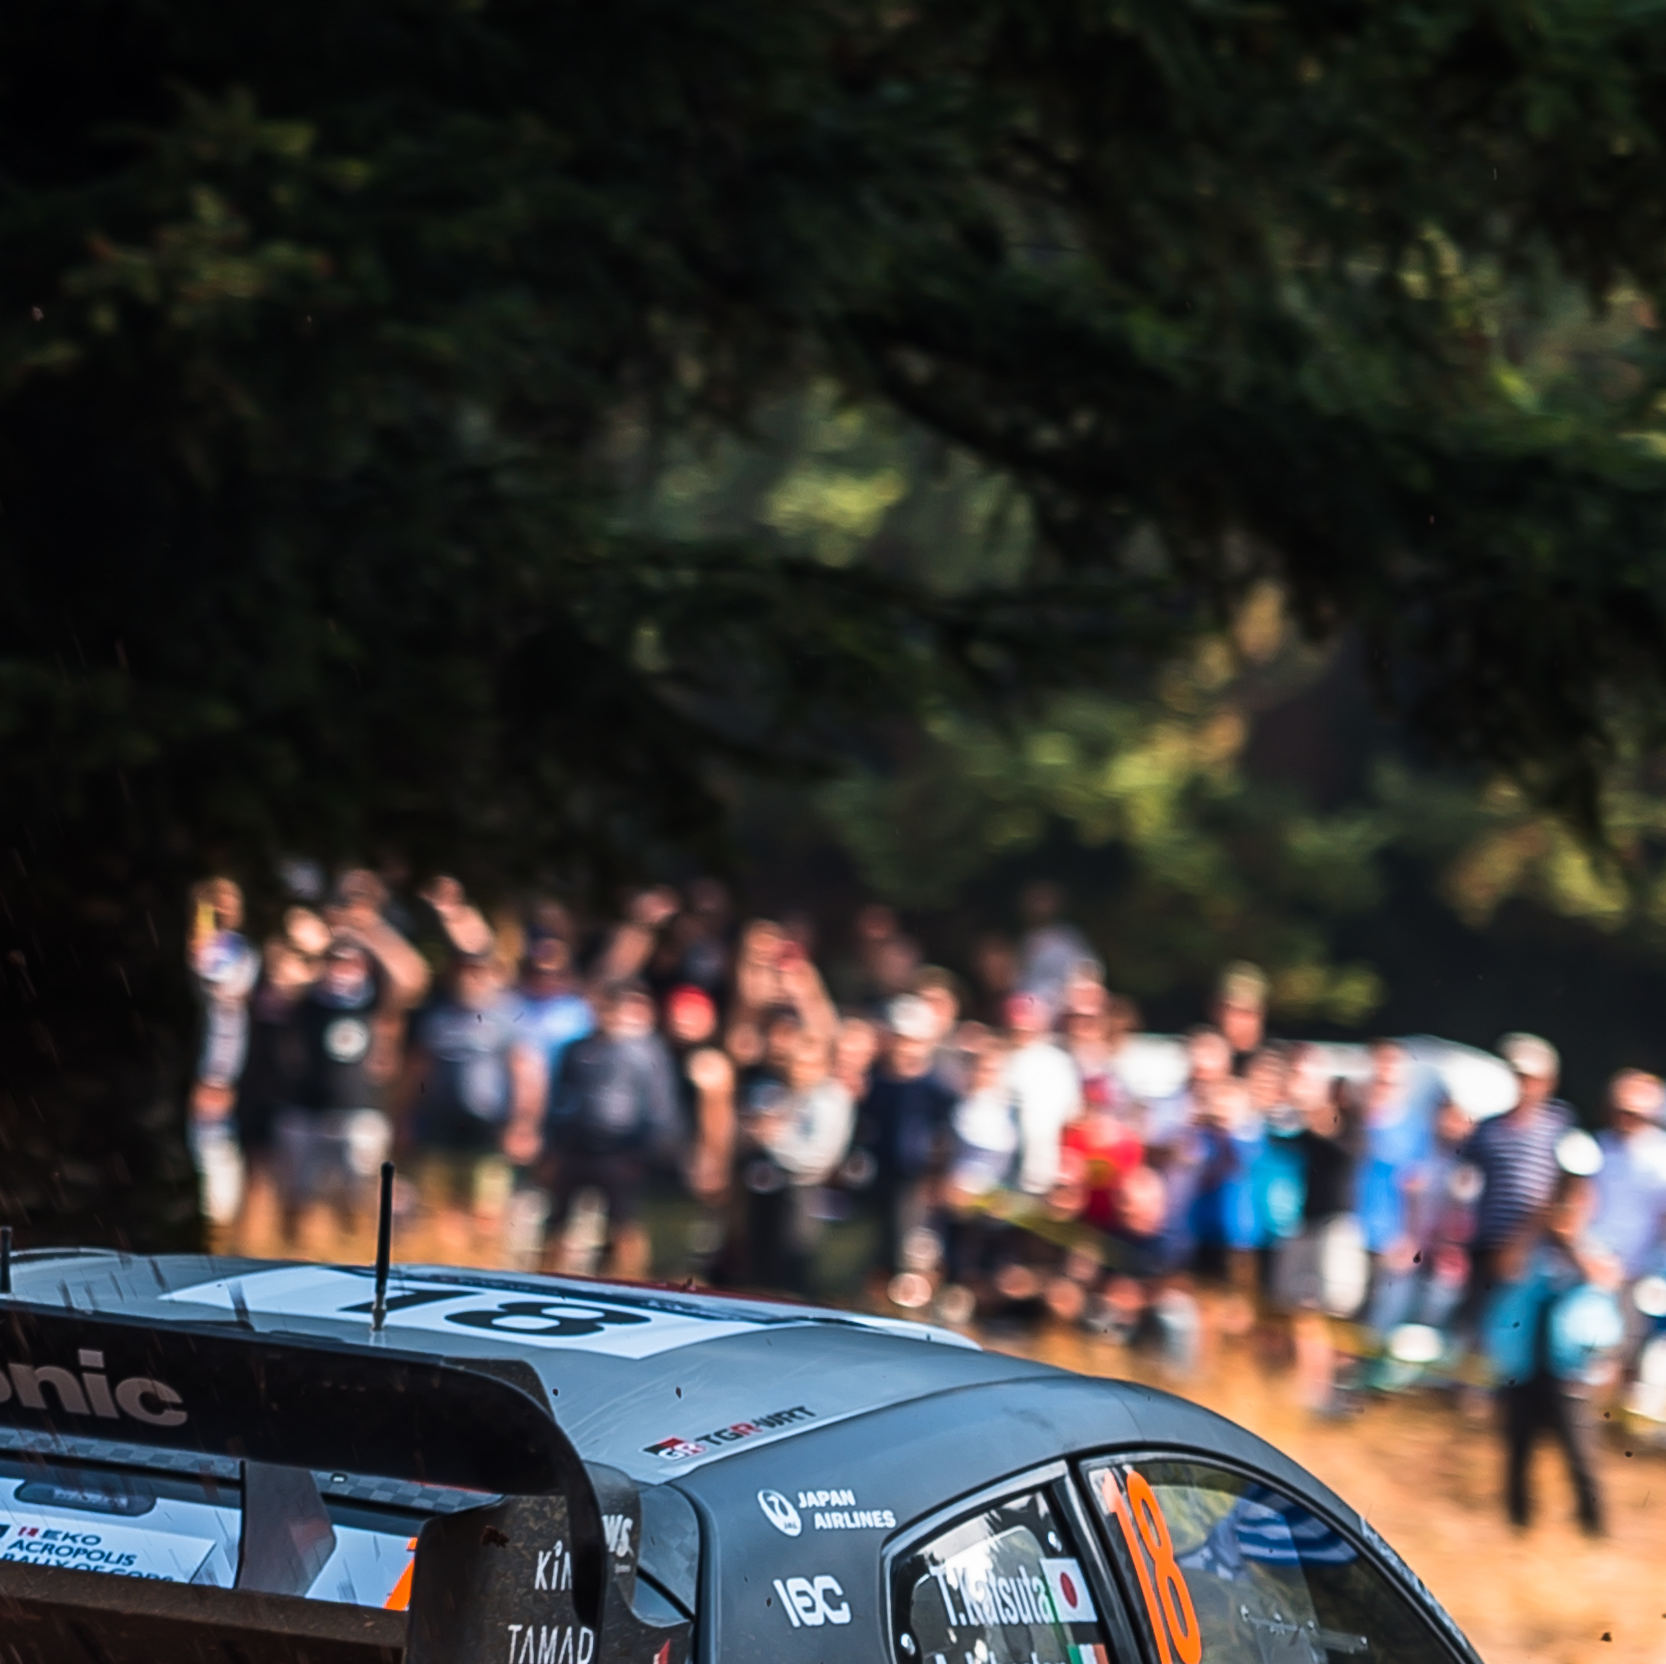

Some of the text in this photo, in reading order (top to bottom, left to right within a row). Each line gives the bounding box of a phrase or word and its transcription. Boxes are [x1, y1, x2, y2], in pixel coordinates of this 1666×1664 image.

[335, 1288, 652, 1338] 18
[798, 1489, 856, 1509] JAPAN
[814, 1509, 896, 1531] AIRLINES
[41, 1529, 102, 1547] EKO
[8, 1539, 138, 1567] ACROPOLIS
[929, 1564, 1056, 1627] T.Katsuta
